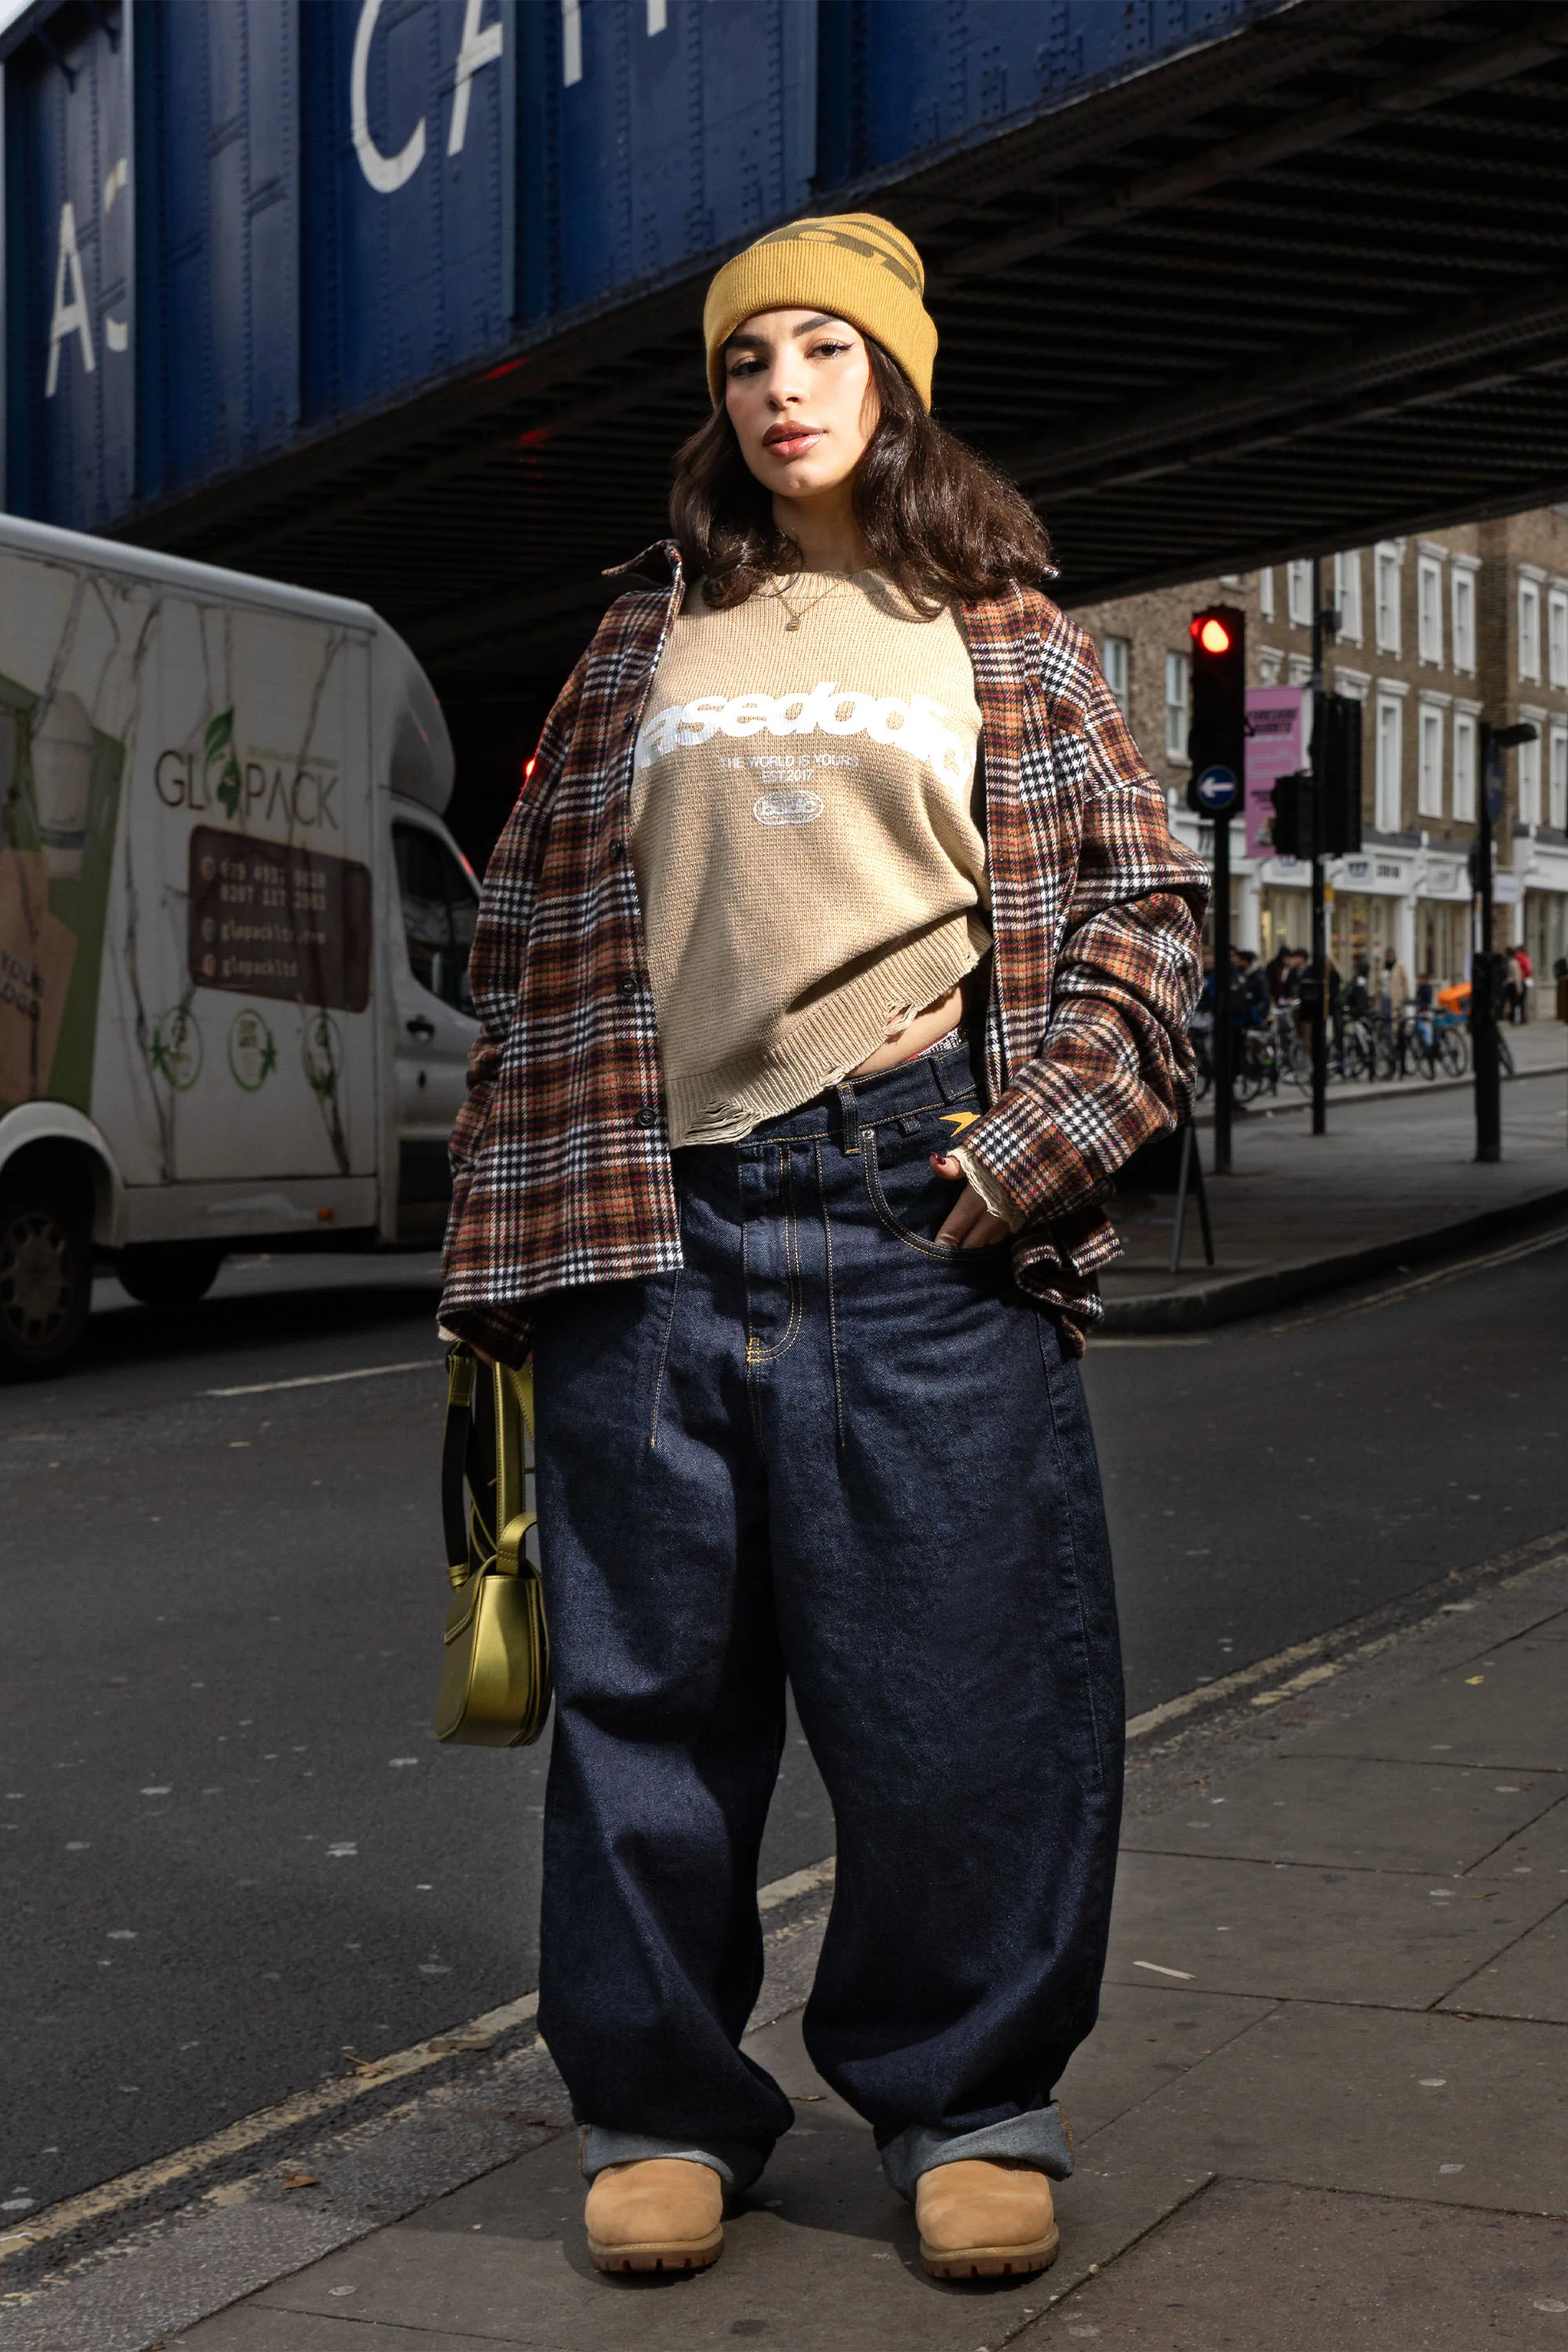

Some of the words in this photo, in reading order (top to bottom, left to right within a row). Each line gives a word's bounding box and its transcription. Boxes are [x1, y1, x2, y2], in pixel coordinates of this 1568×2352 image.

[720, 757, 745, 768] THE
[747, 755, 794, 768] WORLD
[797, 754, 810, 767] IS
[813, 753, 859, 768] YOURS
